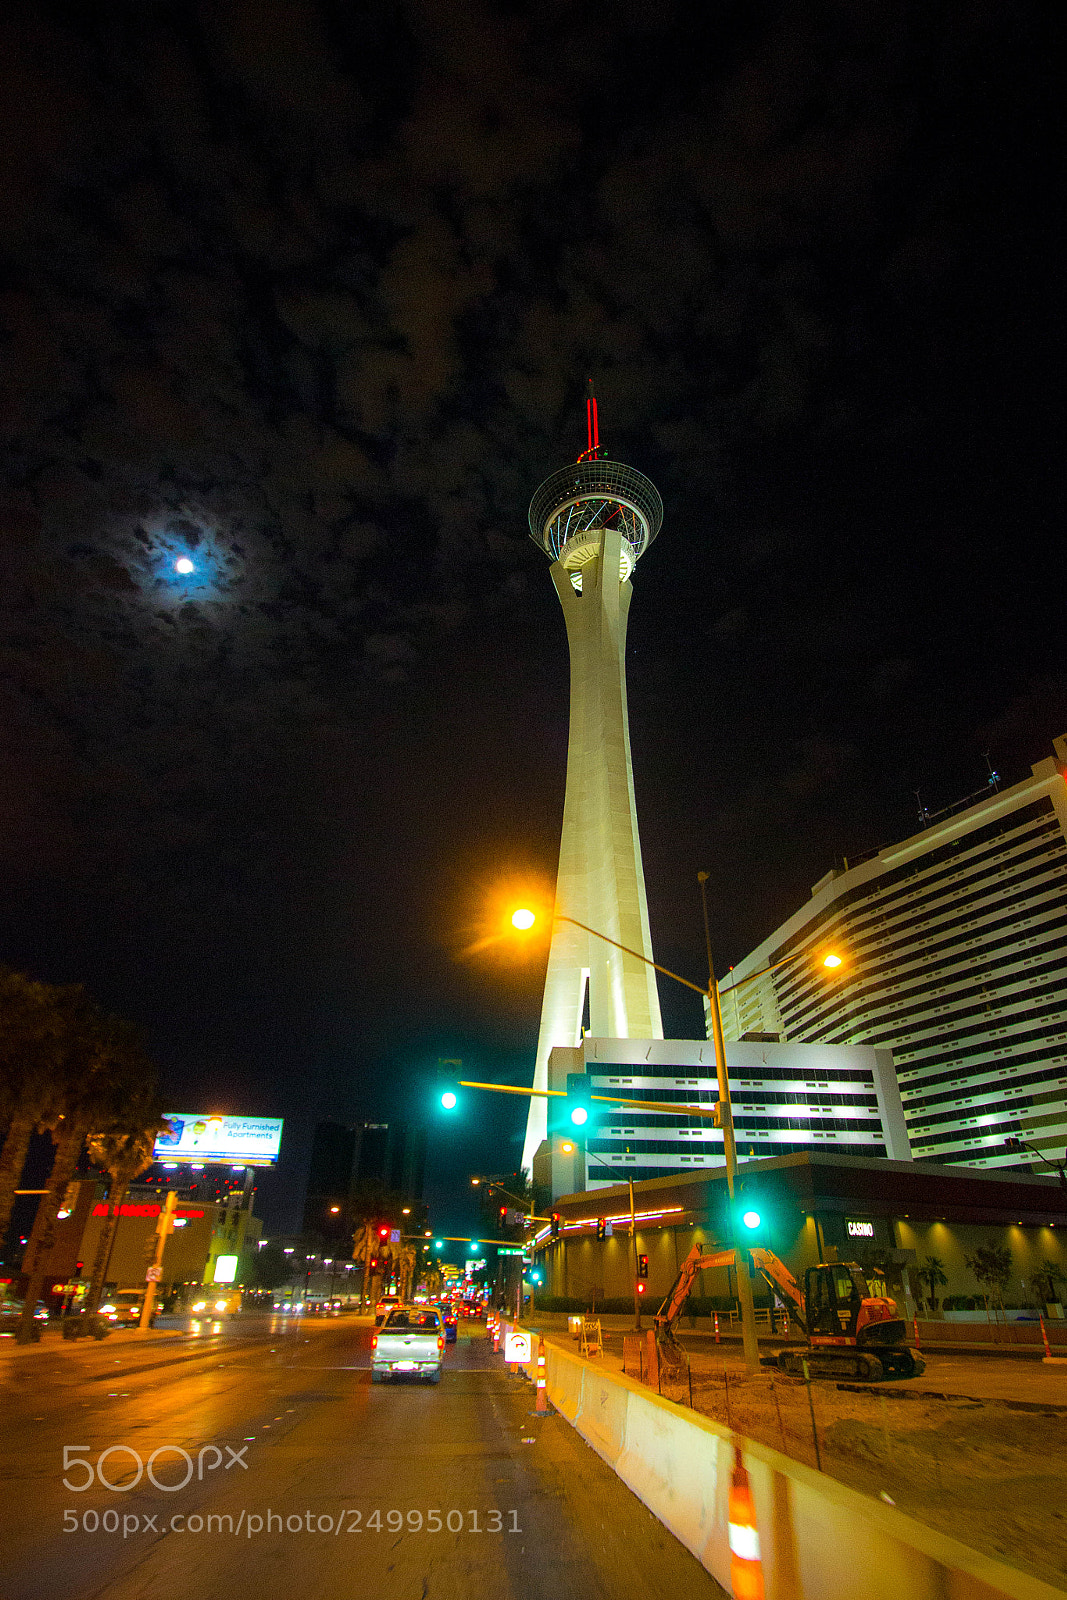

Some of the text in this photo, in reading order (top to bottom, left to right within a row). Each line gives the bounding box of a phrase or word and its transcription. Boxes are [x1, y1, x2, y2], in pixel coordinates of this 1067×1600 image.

[223, 1121, 280, 1132] Fully Furnished
[227, 1130, 273, 1140] Apartments
[848, 1221, 874, 1237] CASINO
